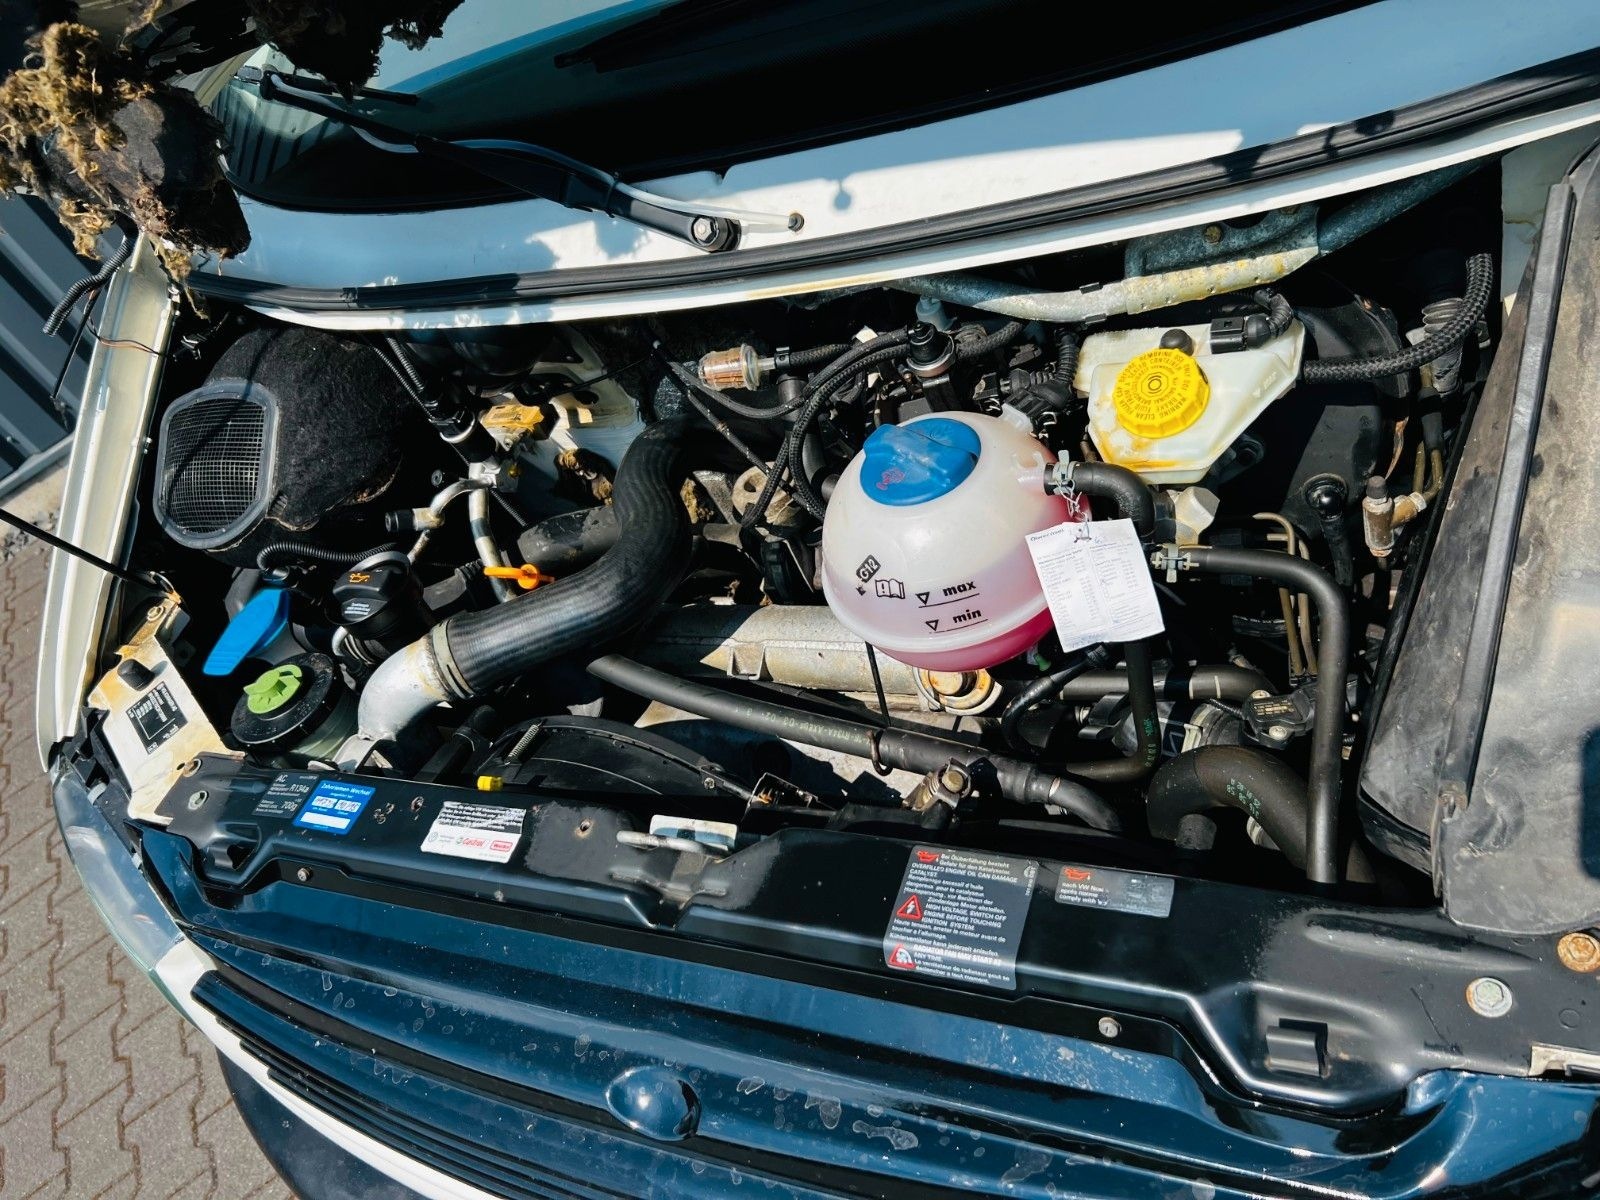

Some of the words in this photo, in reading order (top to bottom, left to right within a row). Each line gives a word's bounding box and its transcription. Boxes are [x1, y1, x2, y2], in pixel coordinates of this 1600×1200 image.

[860, 558, 878, 580] G12
[943, 581, 976, 596] max
[952, 609, 982, 623] min
[276, 774, 289, 782] AC
[288, 783, 310, 794] R134a
[281, 801, 298, 812] 700g
